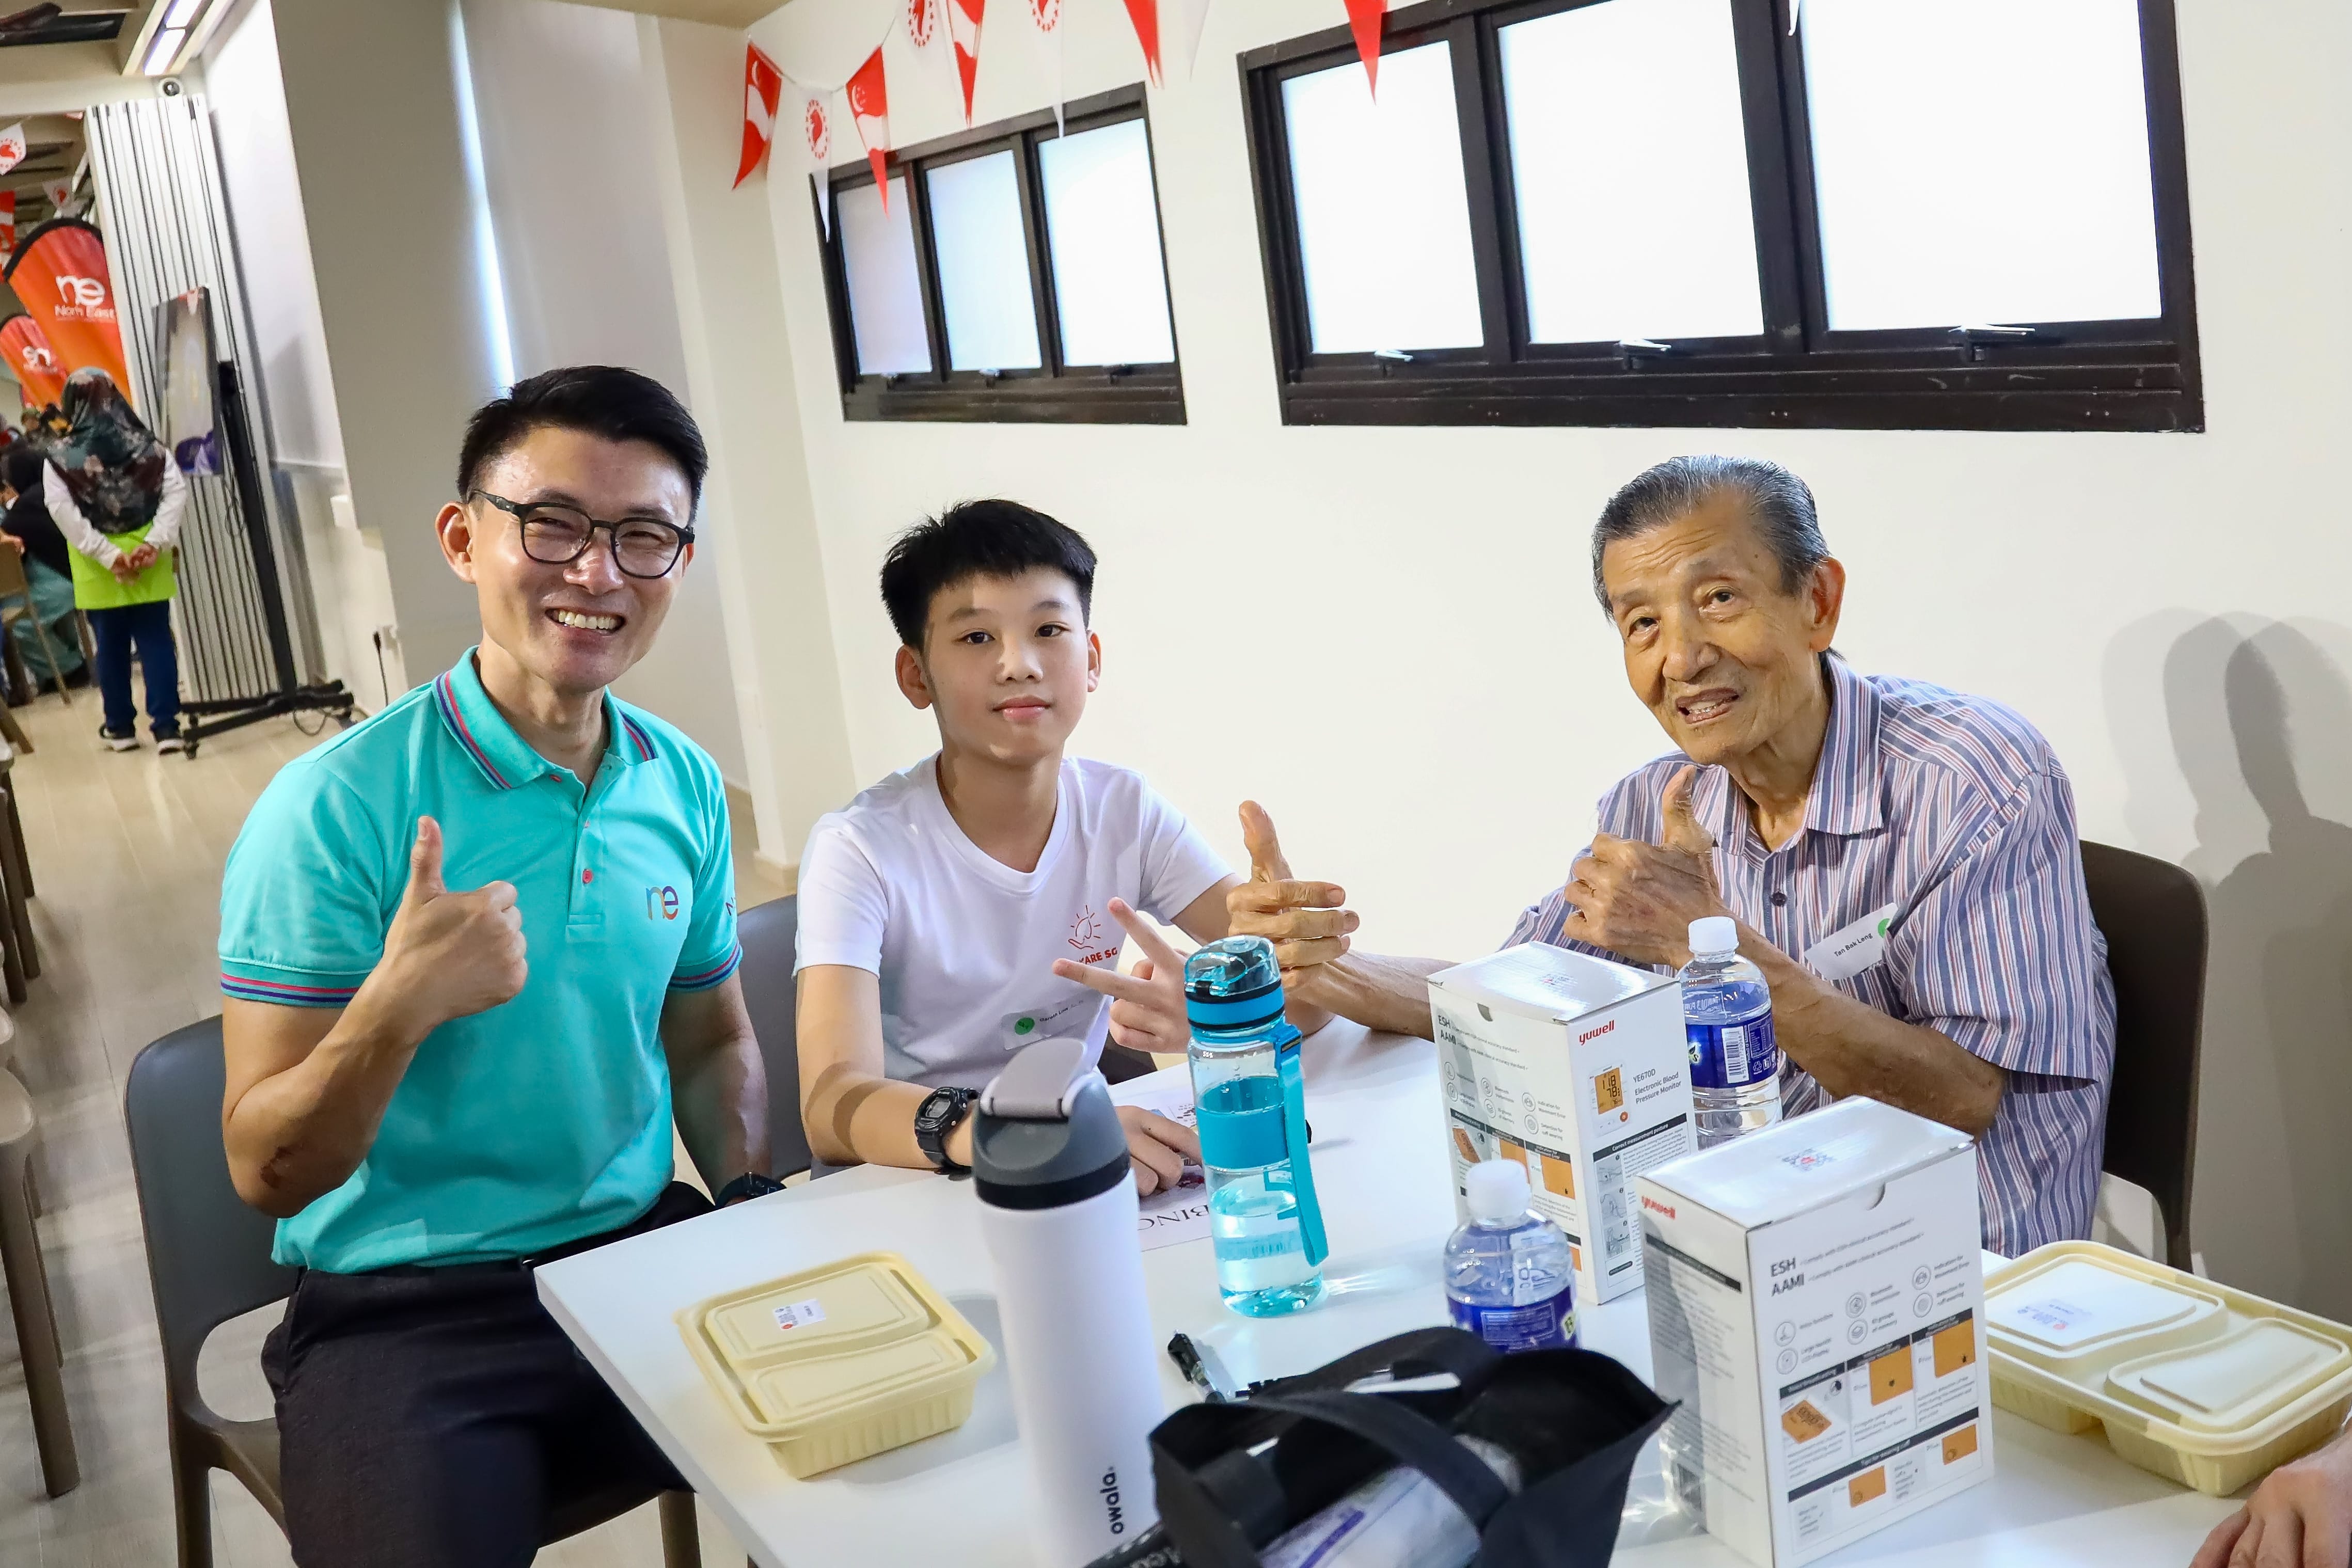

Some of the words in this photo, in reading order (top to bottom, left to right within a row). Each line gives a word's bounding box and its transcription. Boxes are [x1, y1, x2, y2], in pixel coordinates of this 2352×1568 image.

[55, 275, 105, 306] ne
[646, 885, 678, 920] ne
[1104, 947, 1117, 958] SG
[1834, 948, 1845, 957] Tan
[1845, 940, 1858, 951] Bak
[1857, 932, 1873, 944] Leng
[1438, 1015, 1451, 1028] ESH
[1580, 1020, 1614, 1046] yuwell
[1441, 1030, 1456, 1045] AAMI
[1633, 1069, 1656, 1083] YE670D
[1635, 1080, 1663, 1095] Electronic
[1663, 1072, 1679, 1084] Blood
[1636, 1091, 1659, 1104] Pressure
[1660, 1081, 1681, 1094] Monitor
[1612, 1141, 1627, 1151] Correct
[1627, 1130, 1653, 1145] measurement
[1653, 1123, 1668, 1134] posture
[1771, 1257, 1796, 1277] ESH
[1772, 1273, 1804, 1297] AAMI
